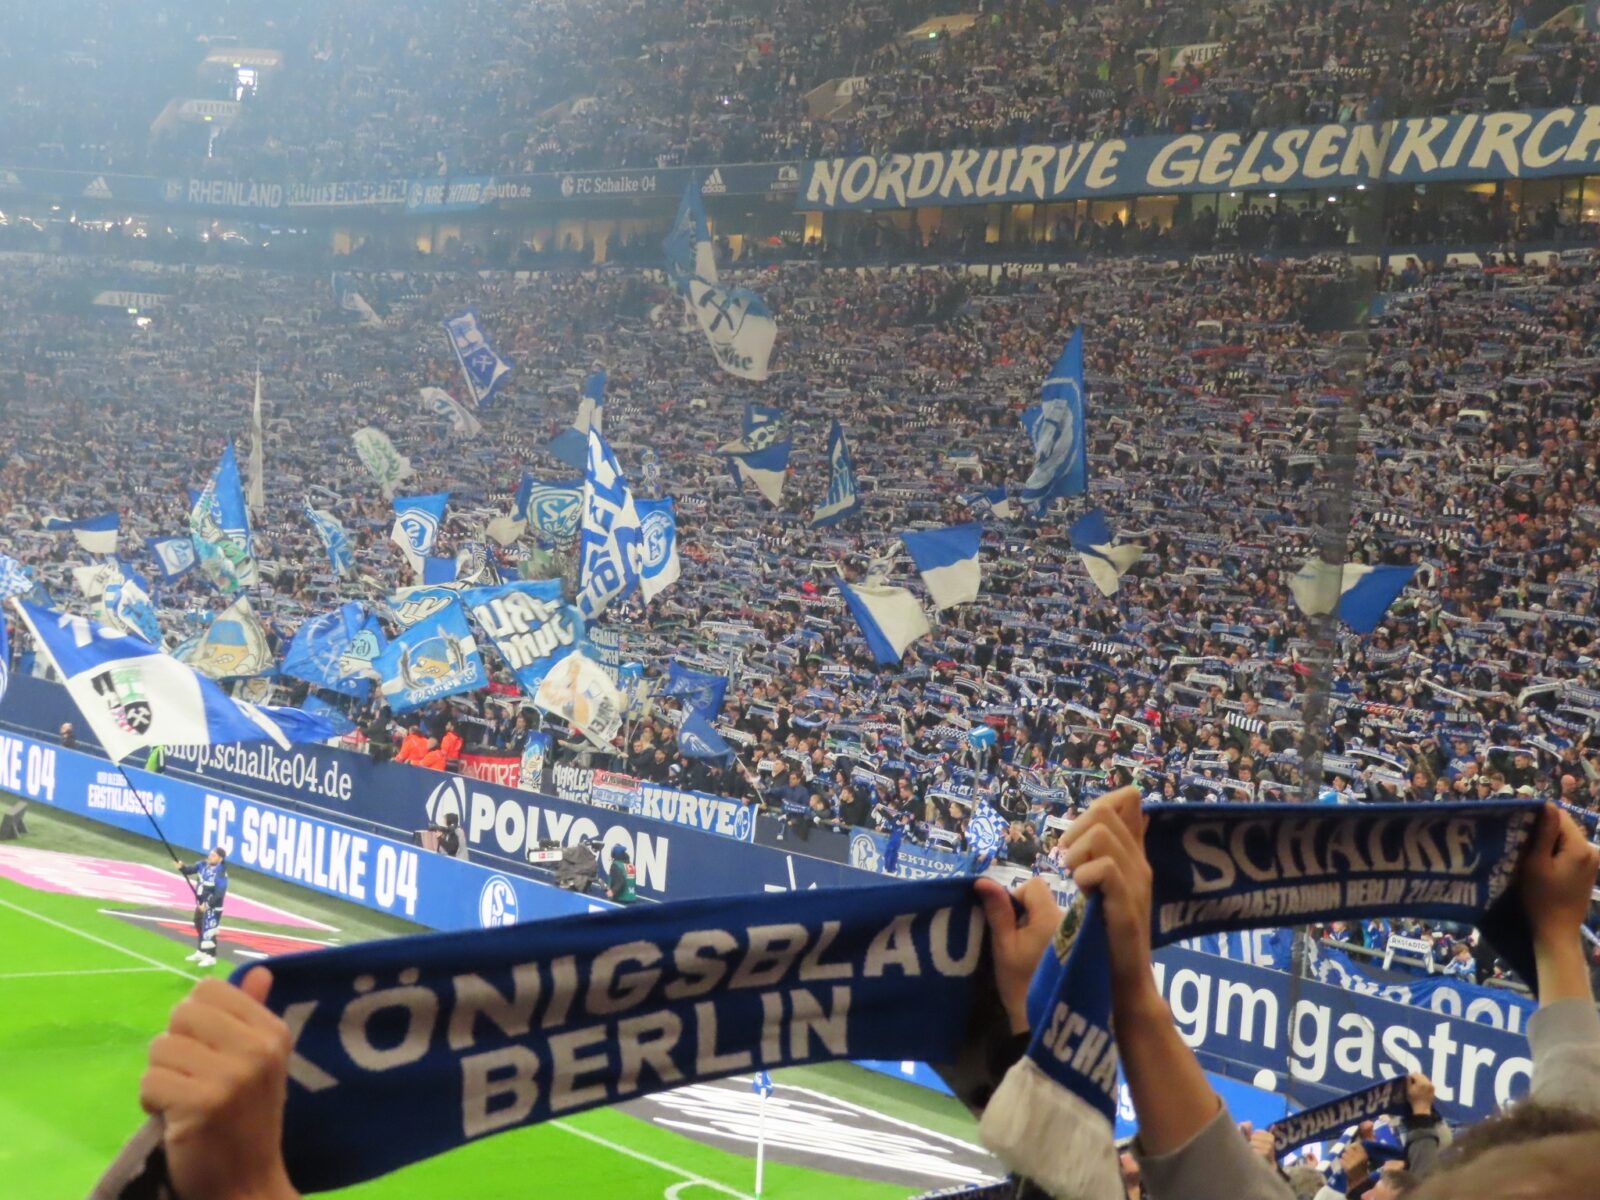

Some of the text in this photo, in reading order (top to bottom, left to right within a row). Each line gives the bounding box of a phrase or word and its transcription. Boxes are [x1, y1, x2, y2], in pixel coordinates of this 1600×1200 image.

[188, 178, 282, 207] RHEINLAND
[576, 175, 656, 194] FC Schalke 04
[806, 139, 1127, 206] NORDKURVE
[27, 744, 56, 800] 04
[467, 791, 669, 893] POLYGON
[641, 787, 737, 836] KURVE
[202, 794, 418, 915] FC SCHALKE 04
[883, 850, 954, 872] EKTION
[1182, 817, 1482, 895] SCHALKE
[1346, 878, 1405, 908] BERLIN
[282, 905, 986, 1093] KÖNIGSBLAU
[460, 985, 851, 1140] BERLIN
[1287, 999, 1533, 1112] gastro
